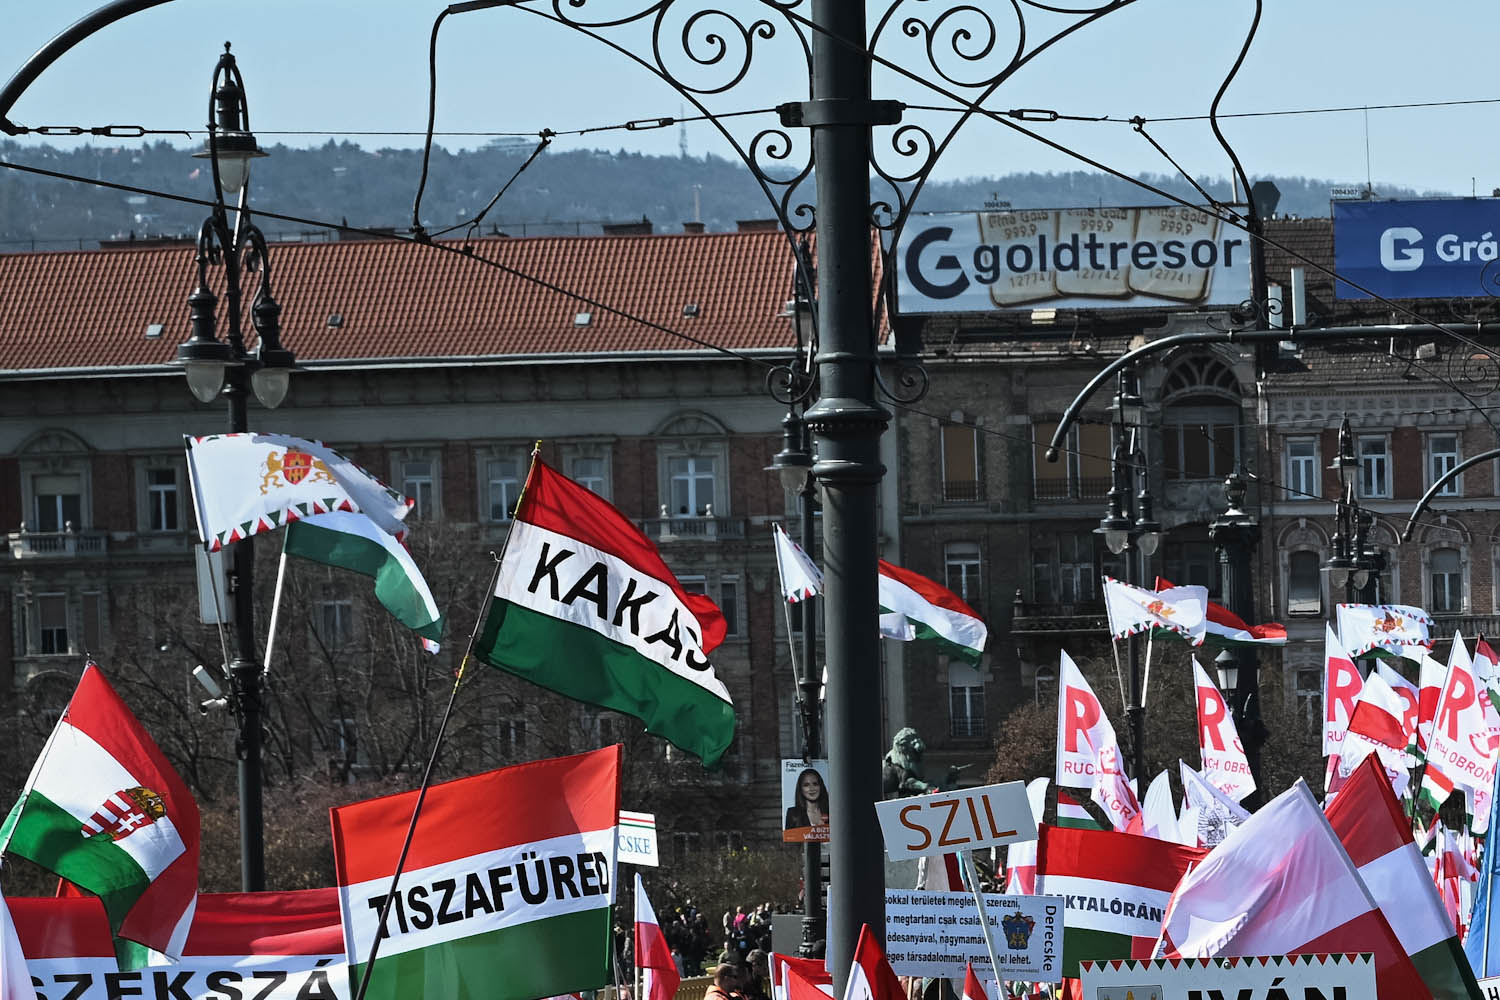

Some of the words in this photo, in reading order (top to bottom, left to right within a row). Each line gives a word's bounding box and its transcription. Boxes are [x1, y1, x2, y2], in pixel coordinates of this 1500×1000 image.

[973, 231, 1243, 285] goldtresor
[618, 834, 651, 854] CSKE
[899, 794, 1018, 851] SZIL
[367, 851, 609, 940] TISZAFÜRED
[938, 913, 957, 925] csak
[986, 897, 1021, 909] szerezni,
[1042, 905, 1057, 972] Derecske
